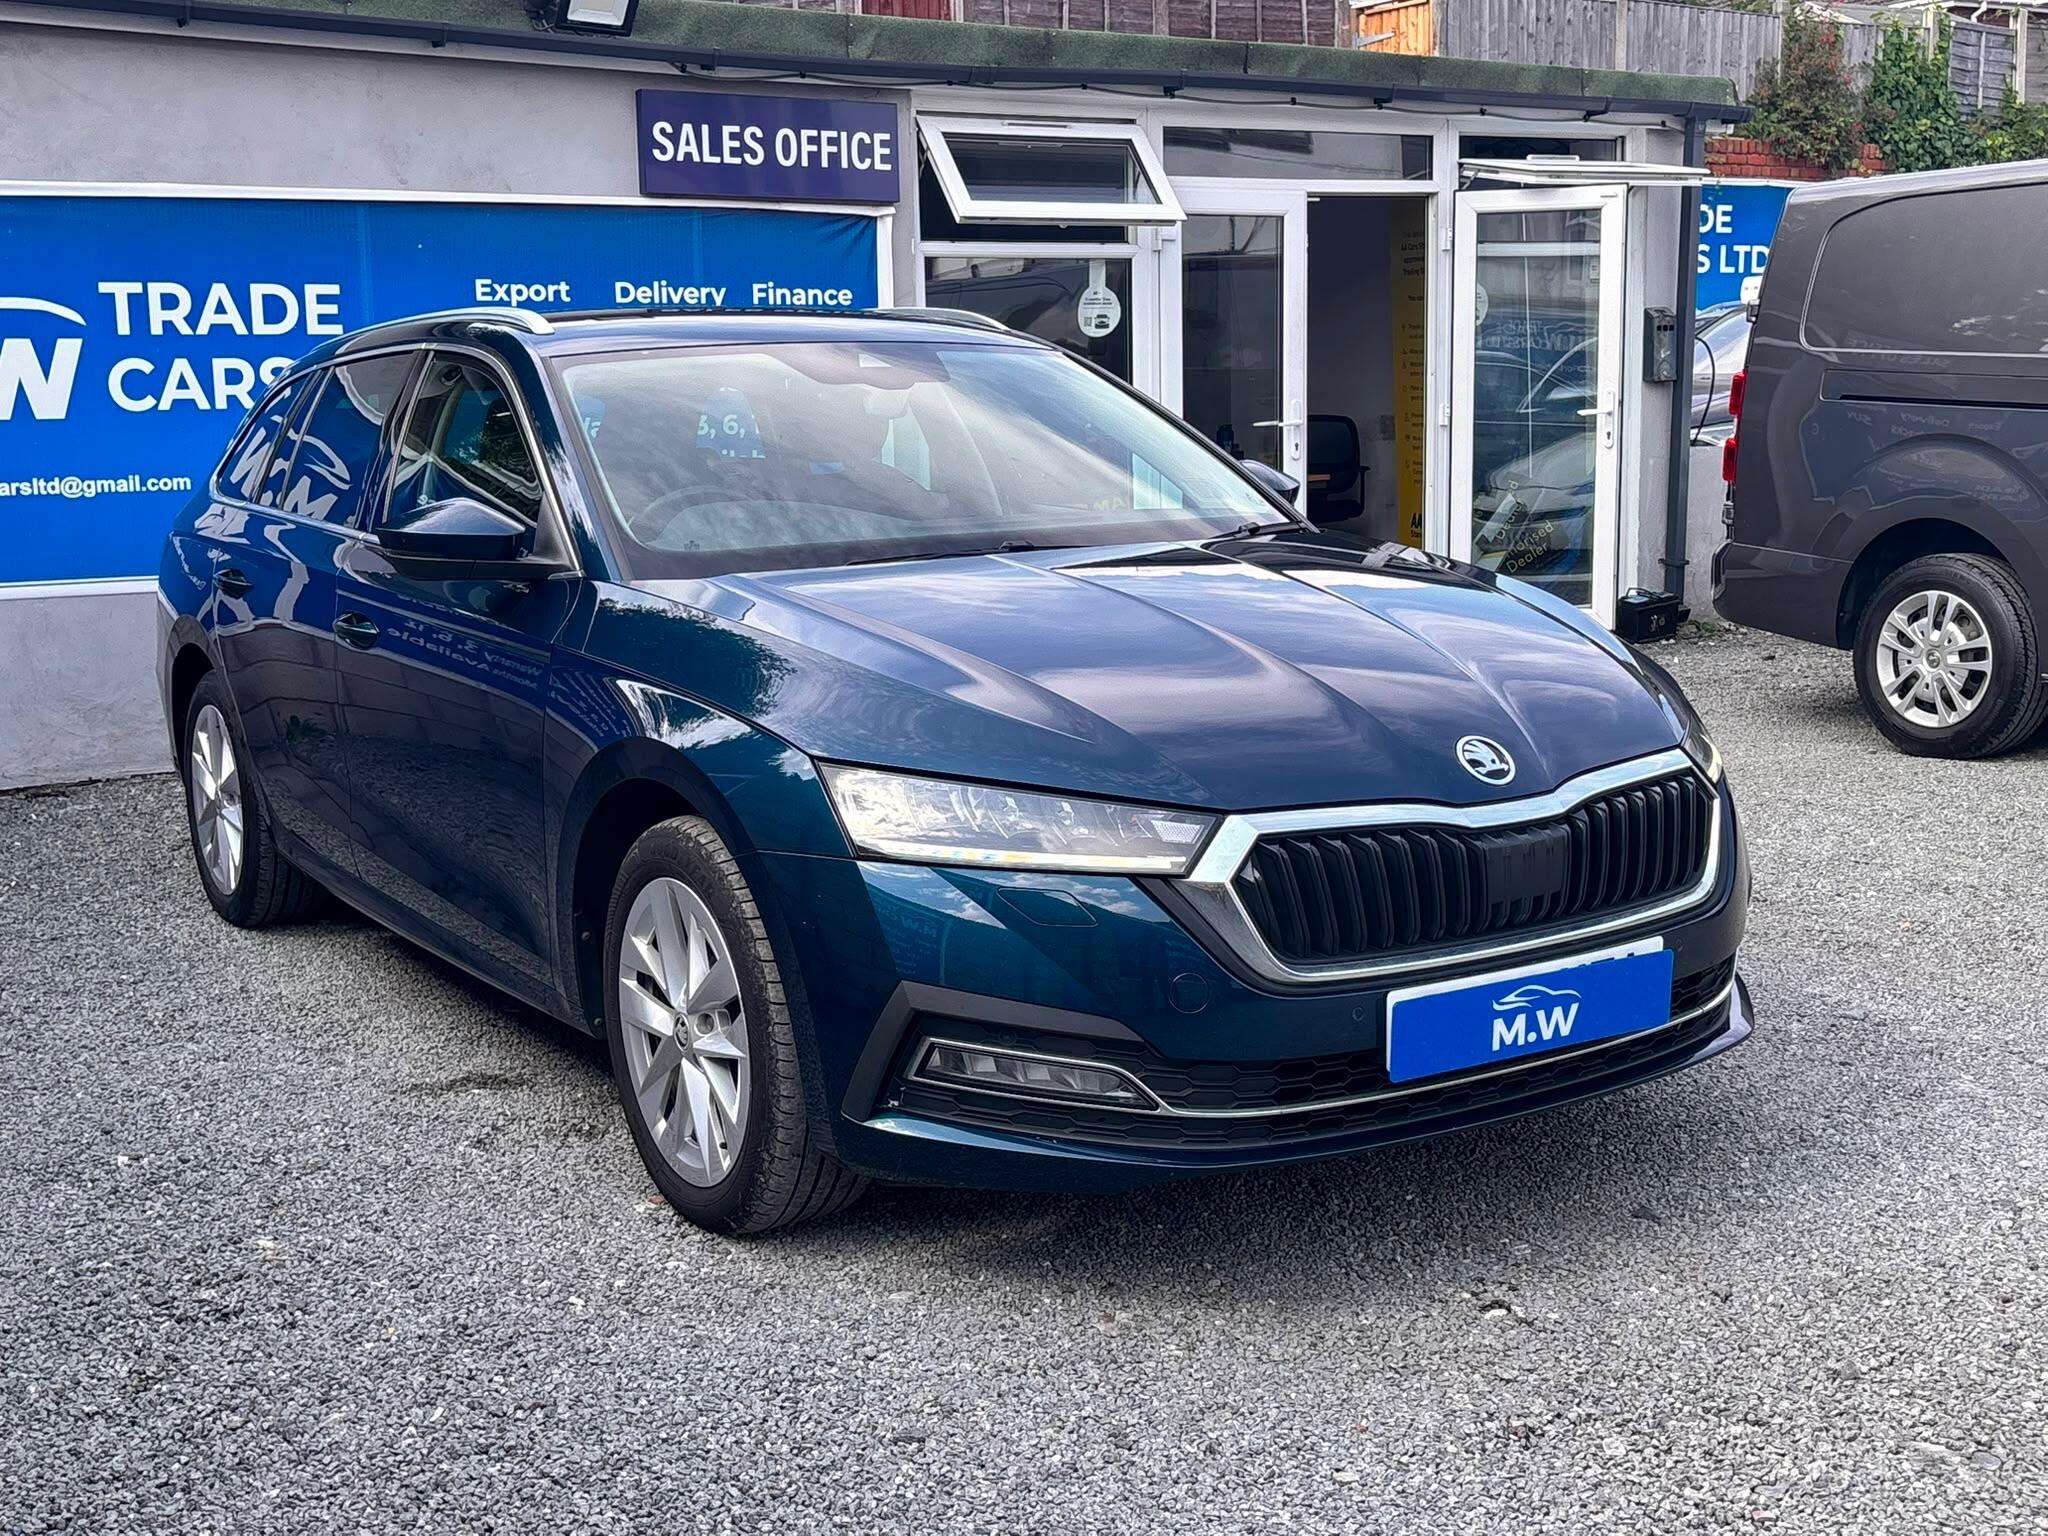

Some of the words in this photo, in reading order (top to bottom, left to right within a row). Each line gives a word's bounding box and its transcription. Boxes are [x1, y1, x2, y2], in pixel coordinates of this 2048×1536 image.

[652, 120, 766, 166] SALES
[774, 127, 893, 171] OFFICE
[1719, 244, 1769, 274] LTD
[97, 281, 344, 336] TRADE
[474, 278, 571, 308] Export
[614, 280, 727, 307] Delivery
[752, 282, 853, 306] Finance
[0, 474, 192, 499] arsltd@gmail.com
[1505, 541, 1549, 574] Dealer
[1491, 1002, 1580, 1052] M.W
